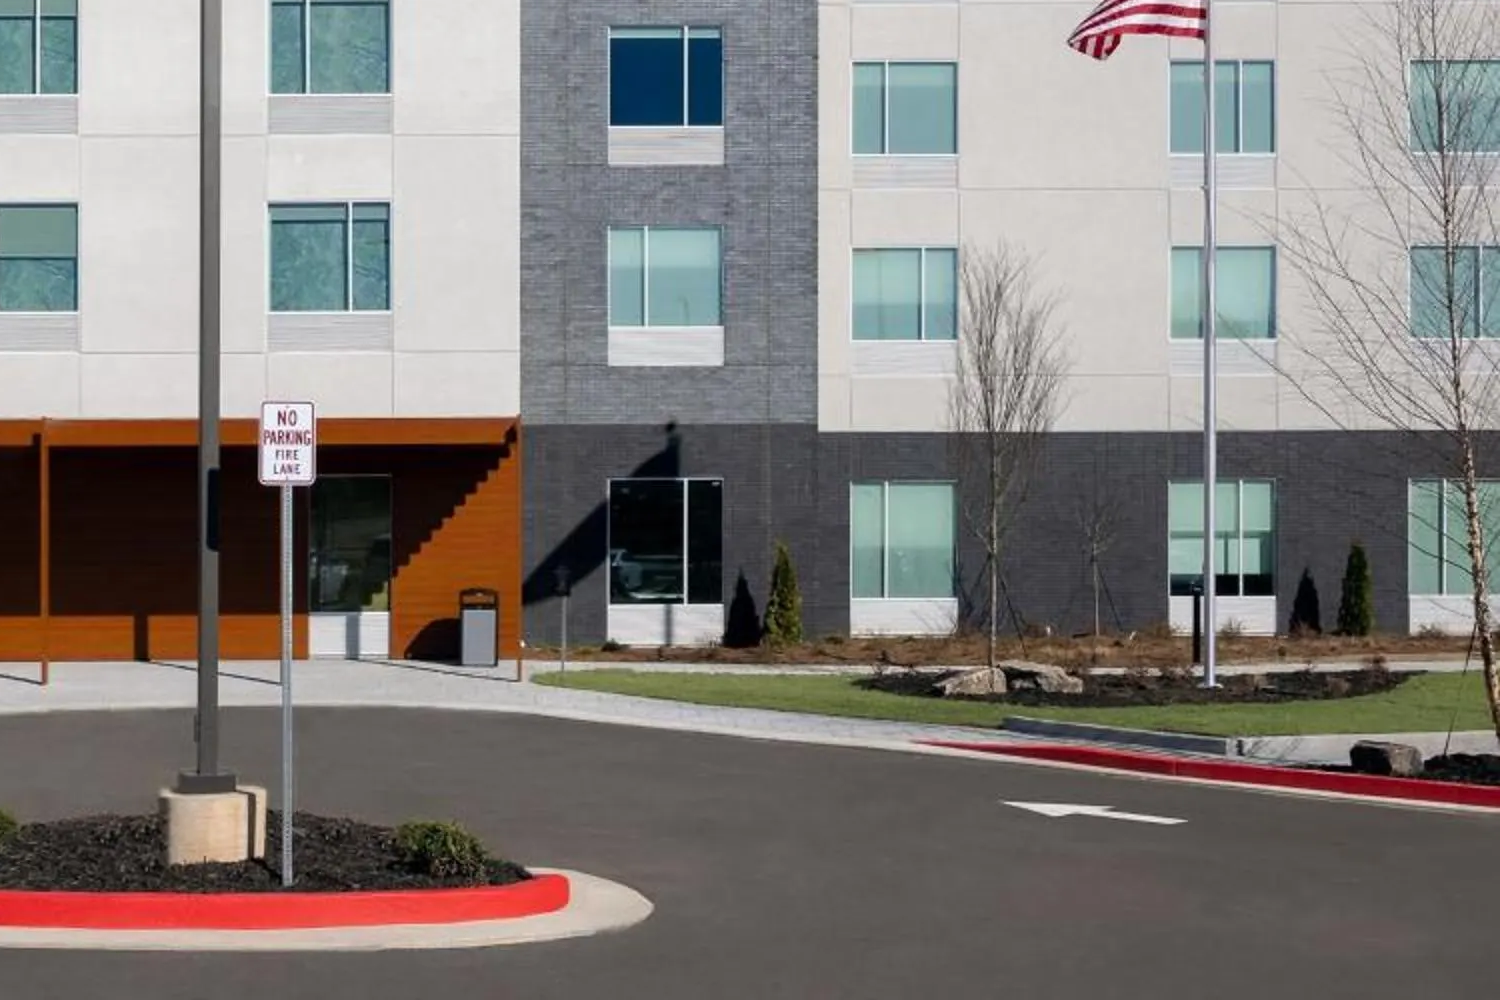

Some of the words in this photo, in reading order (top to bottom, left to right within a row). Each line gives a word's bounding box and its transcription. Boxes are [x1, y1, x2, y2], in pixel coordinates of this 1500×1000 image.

[277, 410, 297, 427] NO
[263, 430, 312, 446] PARKING
[275, 450, 300, 460] FIRE
[273, 463, 301, 475] LANE
